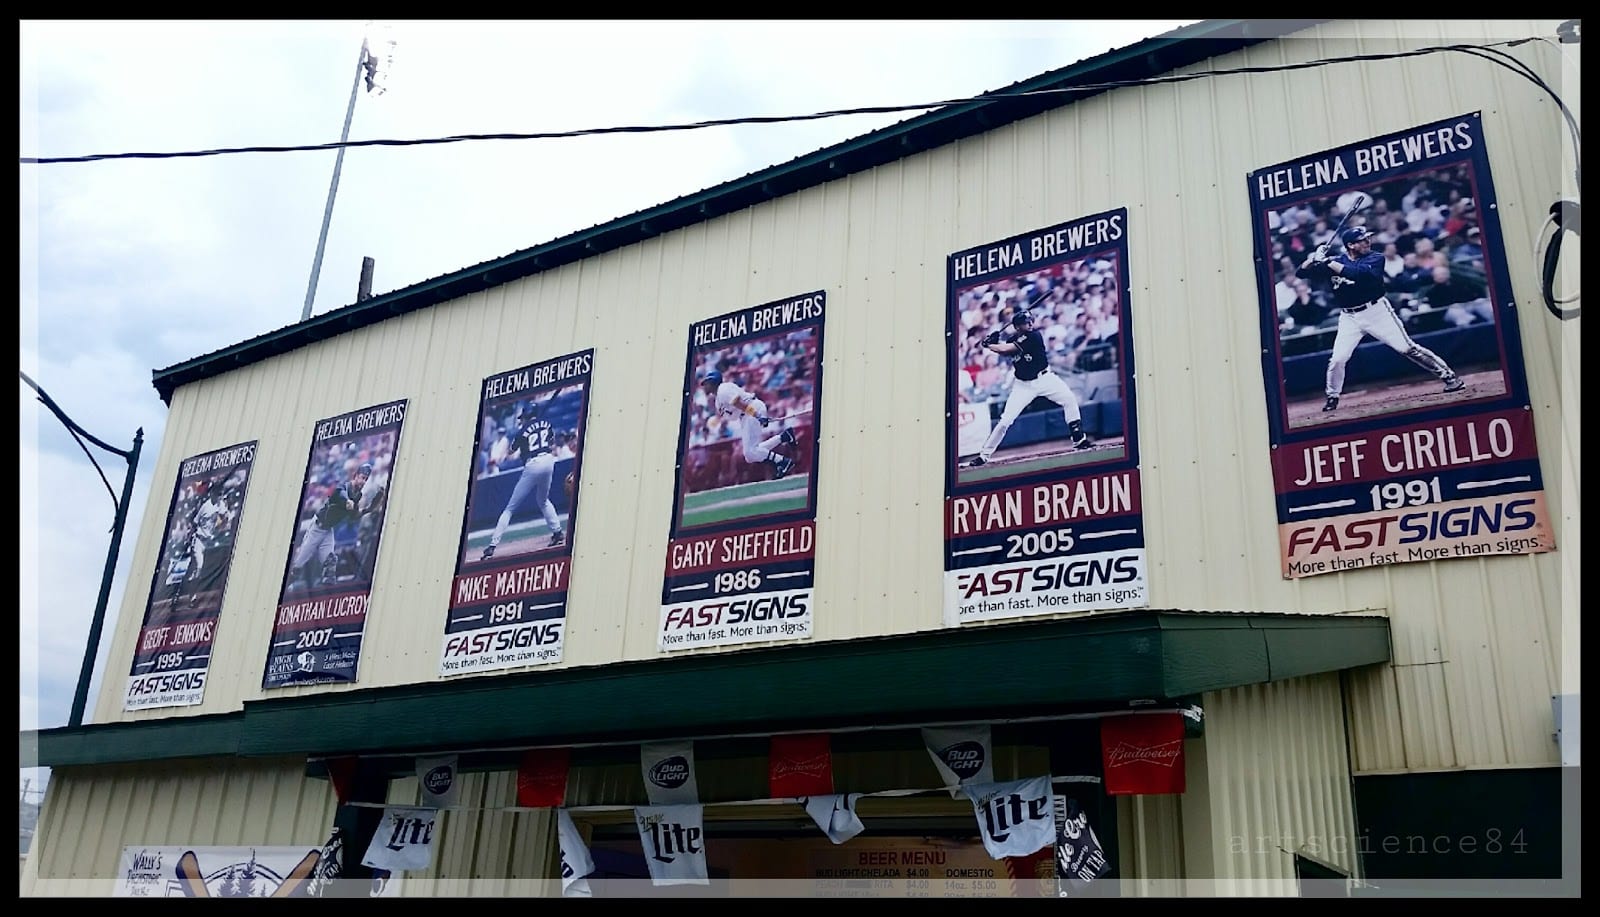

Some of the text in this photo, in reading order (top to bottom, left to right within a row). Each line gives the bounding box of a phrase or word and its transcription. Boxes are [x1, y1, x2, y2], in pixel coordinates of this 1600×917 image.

[1258, 122, 1473, 200] HELENA BREWERS
[954, 215, 1122, 281] HELENA BREWERS
[694, 294, 823, 347] HELENA BREWERS
[485, 353, 591, 400] HELENA BREWERS
[316, 403, 405, 441] HELENA BREWERS
[528, 429, 549, 452] 22
[1294, 418, 1514, 487] JEFF CIRILLO
[181, 444, 256, 478] HELENA BREWERS
[953, 473, 1132, 536] RYAN BRAUN
[1370, 476, 1442, 511] 1991
[1006, 528, 1075, 559] 2005
[1287, 498, 1537, 558] FASTSIGNS
[672, 525, 813, 570] GARY SHEFFIELD
[1288, 555, 1326, 577] More
[1330, 555, 1365, 573] than
[1407, 546, 1450, 564] More
[1453, 540, 1492, 559] than
[457, 561, 565, 604] MIKE MATHENY
[714, 568, 762, 594] 1986
[276, 594, 370, 627] JONATHAN LUCROY
[489, 600, 525, 625] 1991
[663, 593, 809, 632] FASTSIGNS
[958, 601, 976, 616] ore
[978, 597, 1006, 612] than
[1008, 594, 1035, 611] fast.
[1037, 594, 1070, 608] More
[1073, 587, 1102, 604] than
[142, 621, 214, 650] GEOFF JENKINS
[296, 628, 333, 650] 2007
[444, 623, 562, 659] FASTSIGNS
[662, 633, 684, 646] More
[686, 629, 707, 642] than
[730, 625, 754, 638] More
[756, 622, 779, 636] than
[156, 652, 183, 669] 1995
[497, 652, 516, 663] More
[128, 672, 206, 697] FASTSIGNS
[947, 750, 977, 761] BUD
[949, 759, 982, 770] IGHT
[1107, 744, 1181, 761] Budweiser
[656, 771, 687, 781] LIGHT
[661, 764, 684, 773] BUD
[983, 793, 1049, 843] Lite
[651, 822, 702, 864] Lite
[858, 852, 947, 865] BEER MENU
[860, 868, 901, 878] CHELADA
[946, 868, 994, 878] DOMESTIC
